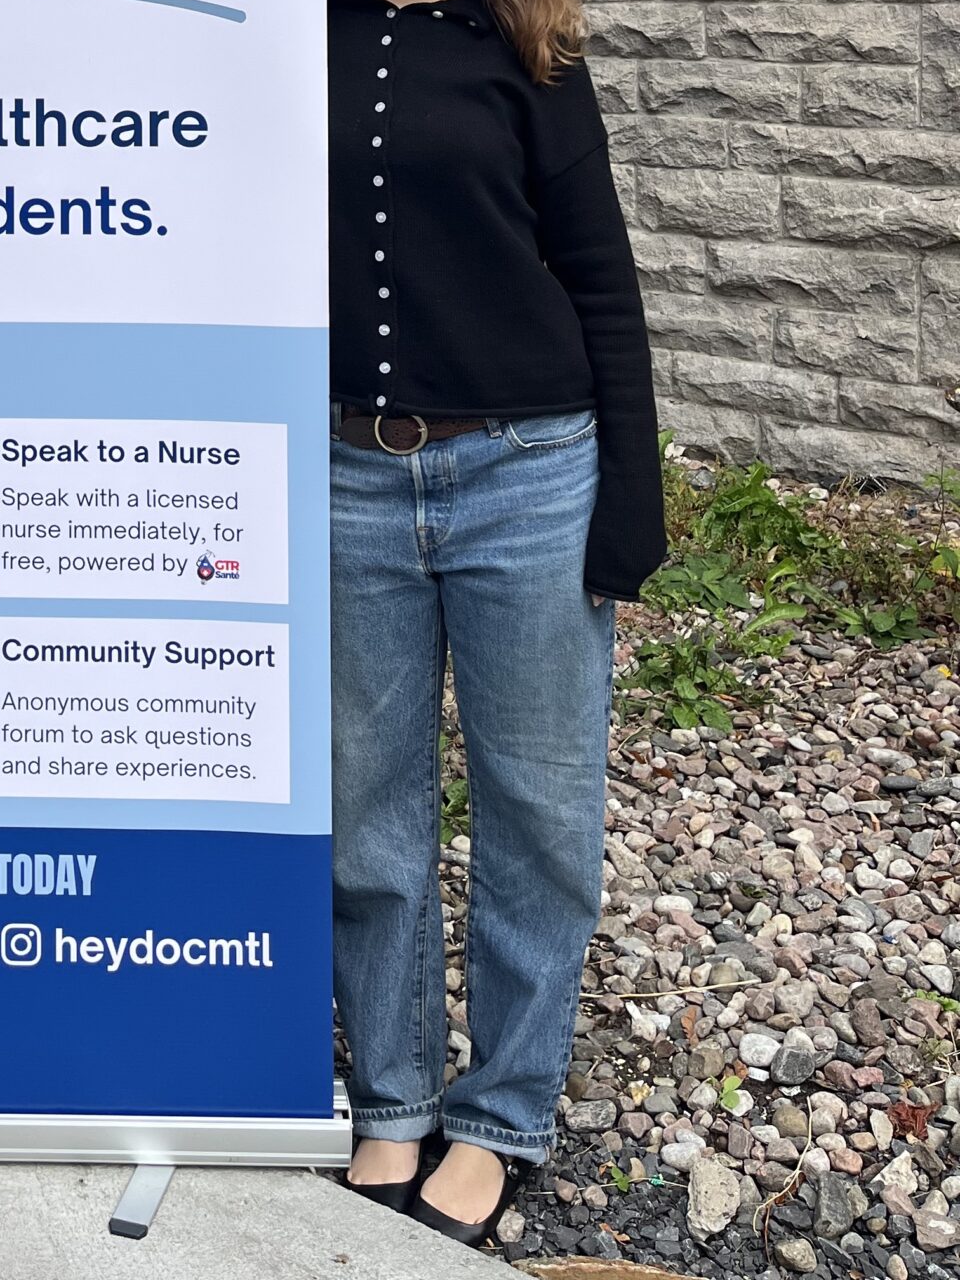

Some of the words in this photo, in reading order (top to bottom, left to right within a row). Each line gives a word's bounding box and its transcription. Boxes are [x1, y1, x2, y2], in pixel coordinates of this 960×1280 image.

[2, 439, 88, 467] Speak
[97, 440, 124, 462] to
[135, 446, 148, 462] a
[159, 441, 240, 465] Nurse
[2, 488, 69, 510] Speak
[77, 489, 119, 507] with
[128, 494, 138, 507] a
[147, 489, 238, 509] licensed
[3, 524, 60, 538] nurse
[69, 520, 205, 545] immediately,
[214, 523, 243, 542] for
[2, 551, 50, 573] free,
[59, 553, 154, 574] powered
[163, 554, 187, 576] by
[214, 560, 240, 571] GTR
[215, 571, 240, 580] Santé
[2, 639, 156, 668] Community
[165, 641, 275, 670] Support
[2, 692, 128, 715] Anonymous
[137, 696, 256, 719] community
[2, 724, 63, 743] forum
[72, 725, 93, 743] to
[101, 726, 137, 744] ask
[145, 727, 251, 749] questions
[2, 756, 40, 774] and
[49, 757, 108, 775] share
[116, 758, 257, 781] experiences.
[56, 928, 273, 971] heydocmtl
